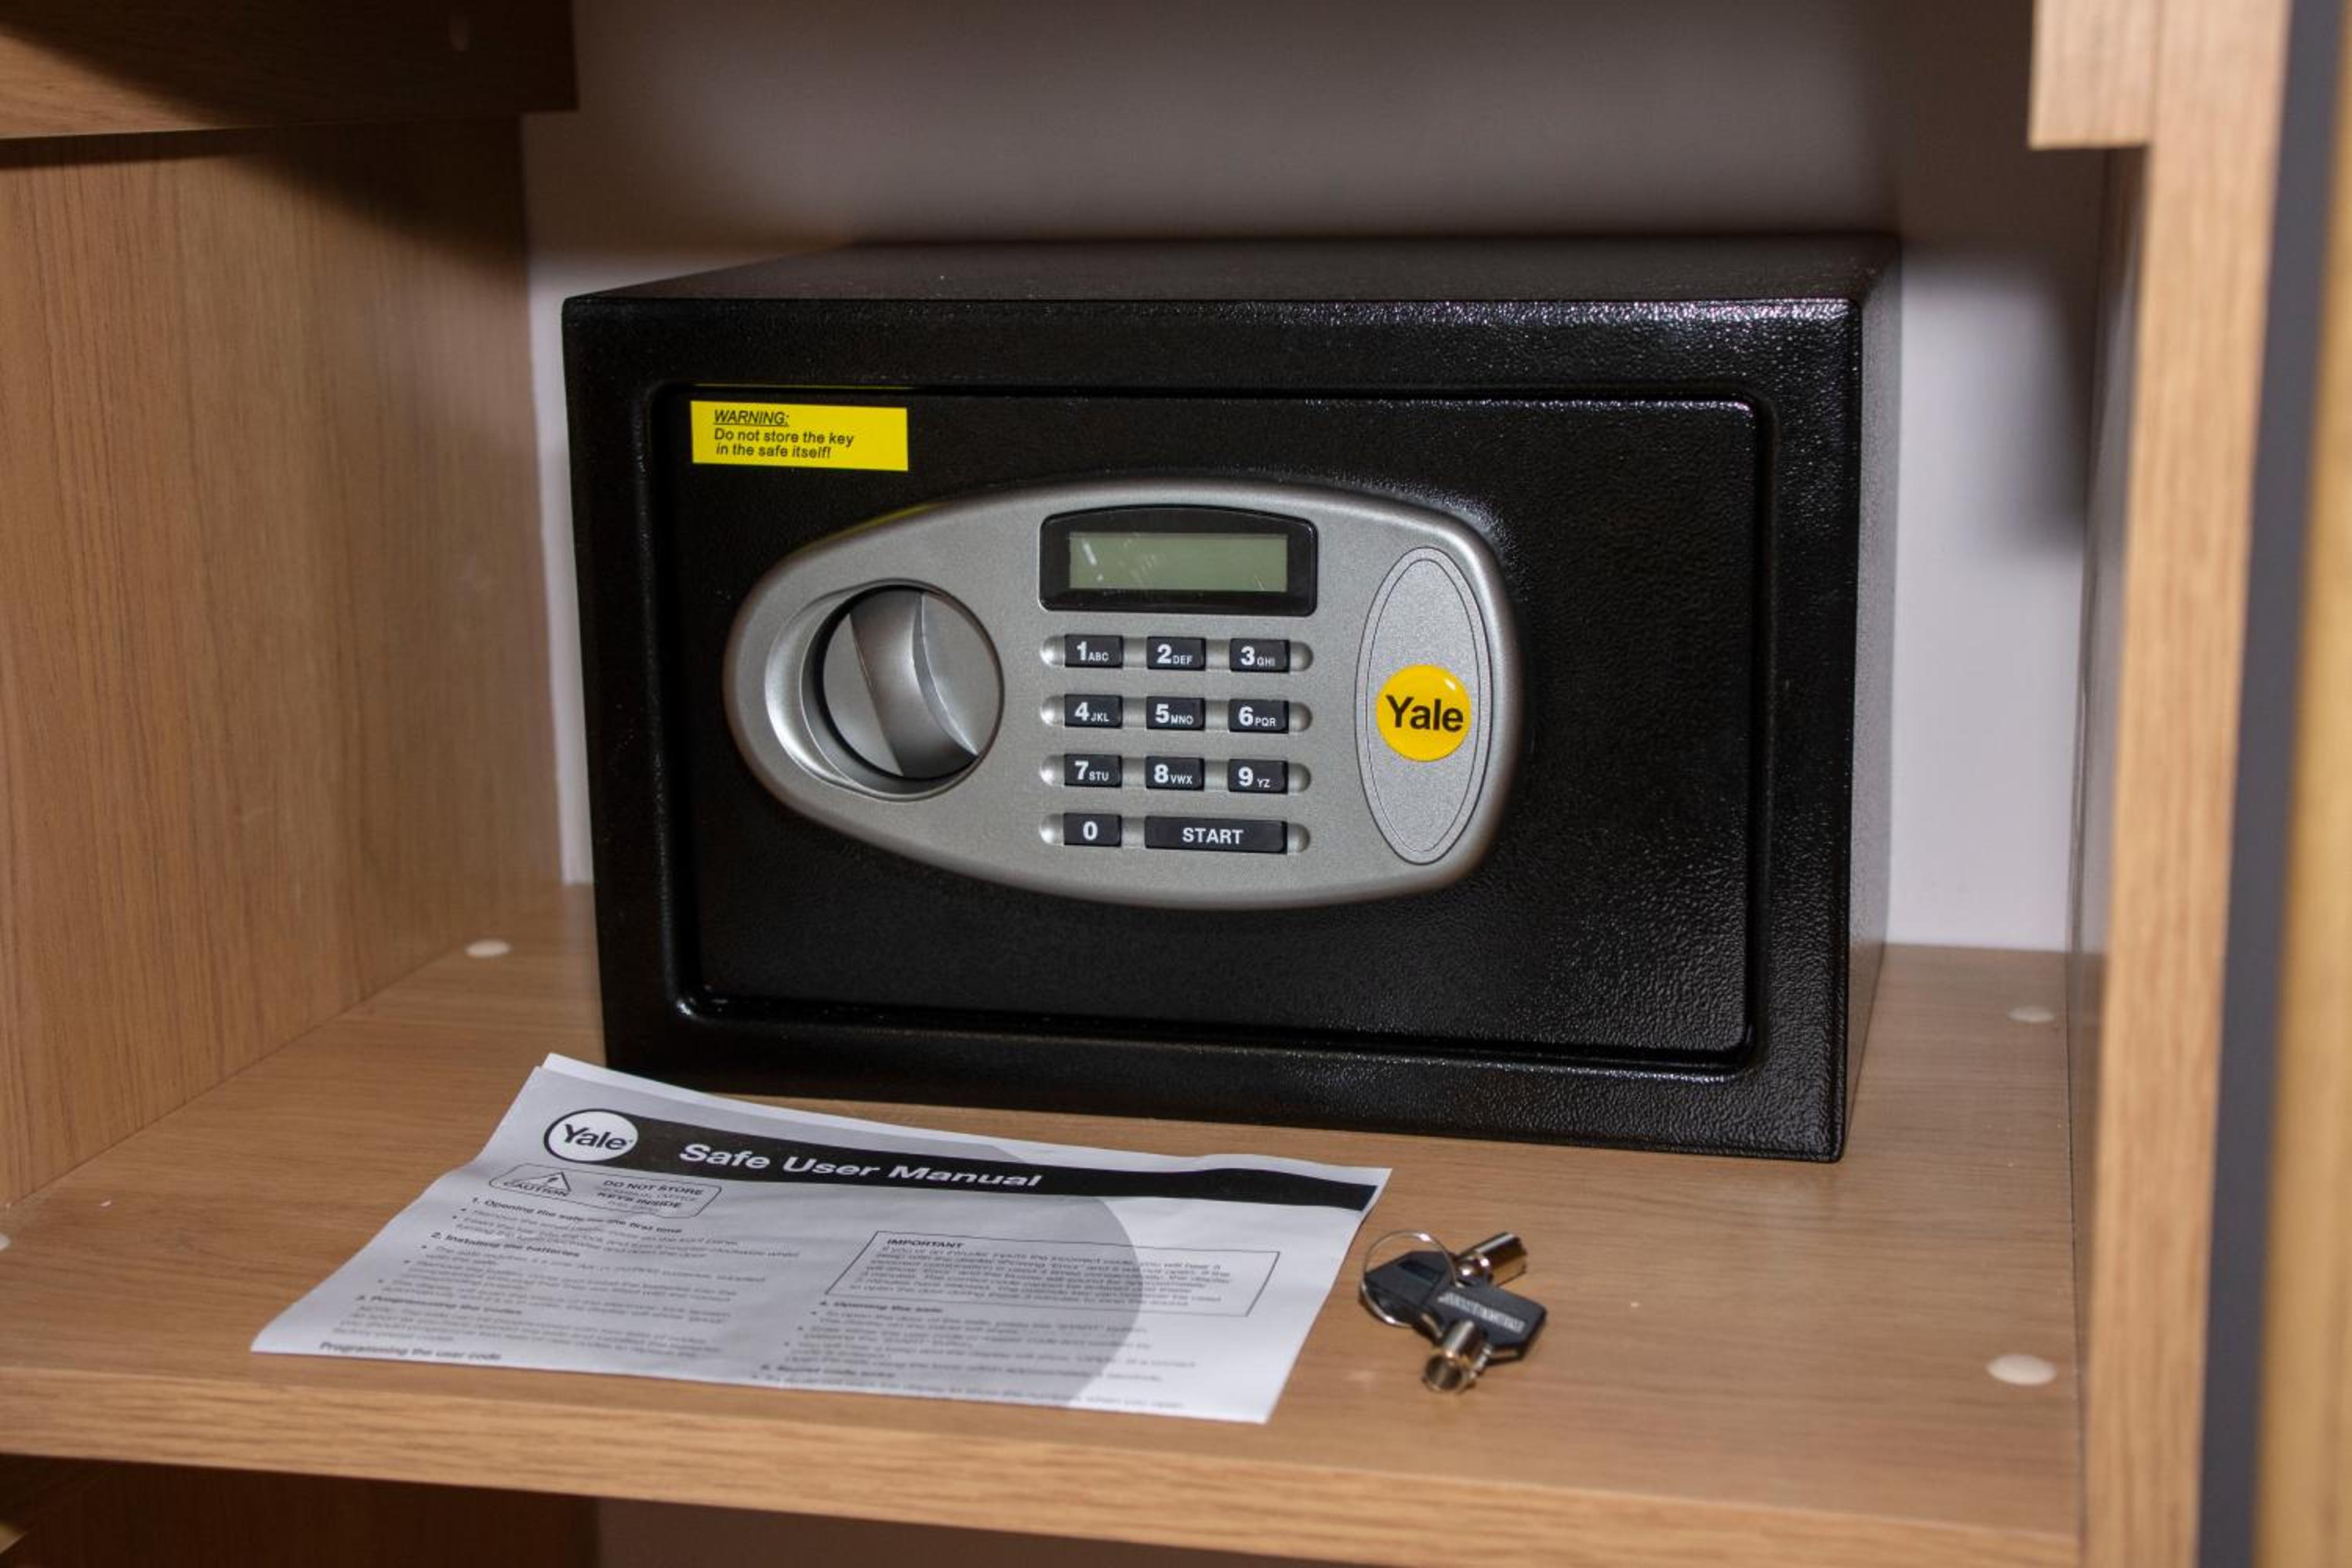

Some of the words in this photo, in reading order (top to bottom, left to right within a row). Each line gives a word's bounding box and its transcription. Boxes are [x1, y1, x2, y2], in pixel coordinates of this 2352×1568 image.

[714, 409, 789, 426] WARNING:
[714, 428, 734, 440] Do
[738, 430, 759, 441] not
[764, 431, 799, 443] store
[803, 431, 824, 444] the
[829, 433, 854, 447] key
[716, 443, 728, 455] in
[733, 444, 753, 456] the
[758, 445, 788, 457] safe
[792, 445, 831, 459] itself!
[1386, 695, 1464, 732] Yale
[1083, 821, 1098, 840] 0
[1182, 828, 1243, 845] START
[562, 1124, 628, 1151] Yale
[679, 1143, 771, 1171] Safe
[782, 1156, 880, 1178] User
[887, 1165, 1043, 1188] Manual
[503, 1181, 569, 1197] CAUTION
[626, 1182, 656, 1191] NOT
[657, 1185, 704, 1196] STORE
[484, 1200, 535, 1214] Opening
[597, 1192, 634, 1202] KEYS
[636, 1198, 683, 1209] INSIDE
[887, 1239, 965, 1248] IMPORTANT
[319, 1341, 409, 1357] Programming
[412, 1347, 433, 1356] the
